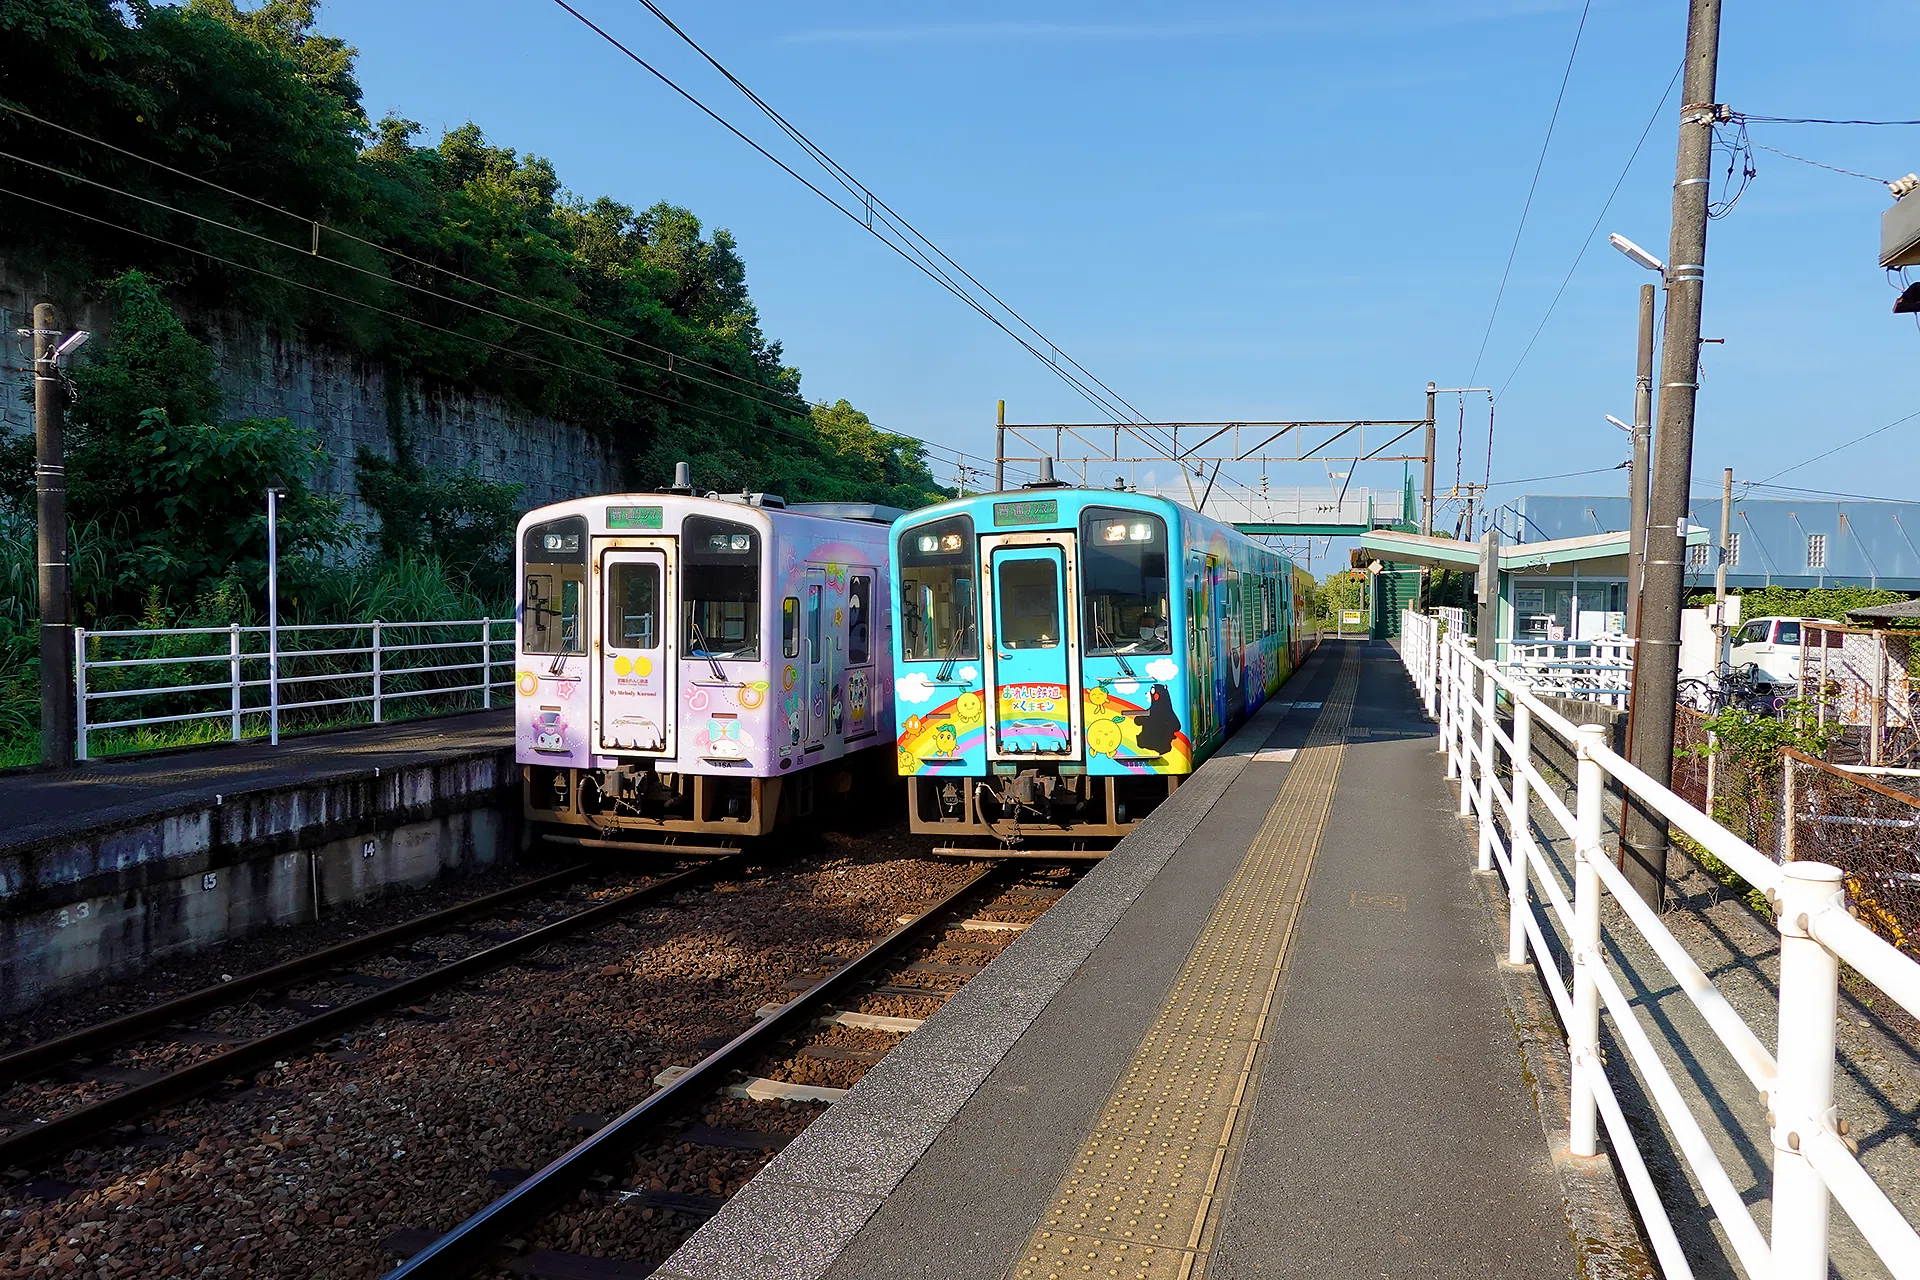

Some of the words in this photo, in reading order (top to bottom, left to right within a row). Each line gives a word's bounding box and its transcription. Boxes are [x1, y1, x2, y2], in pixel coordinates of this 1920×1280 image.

[1002, 686, 1062, 700] おれんじ鉄道
[363, 842, 375, 857] 14
